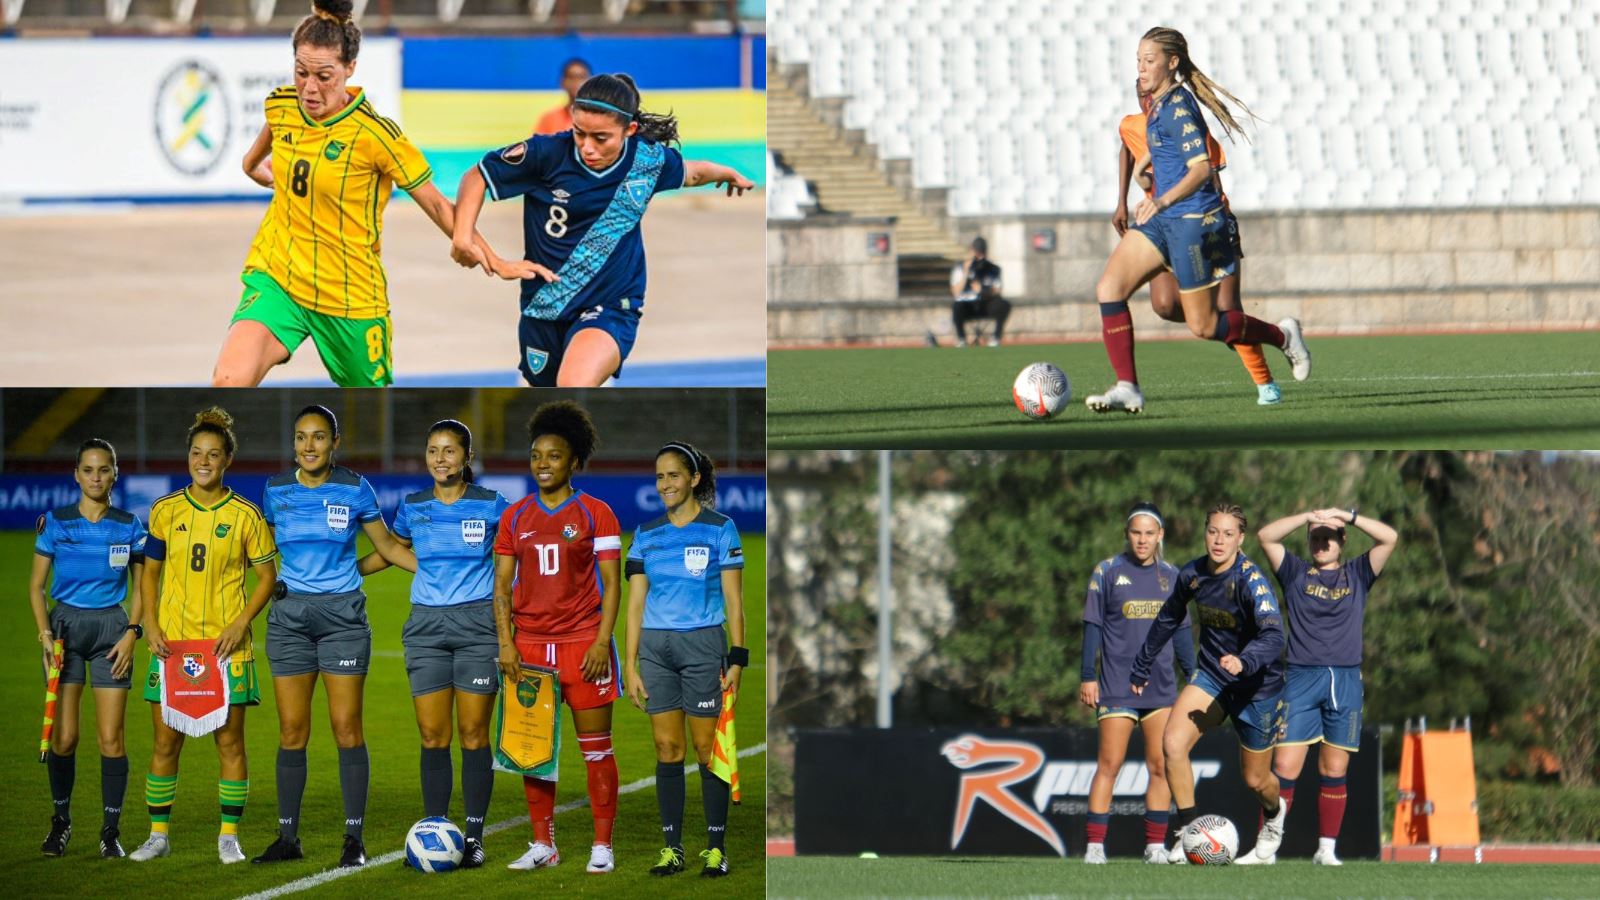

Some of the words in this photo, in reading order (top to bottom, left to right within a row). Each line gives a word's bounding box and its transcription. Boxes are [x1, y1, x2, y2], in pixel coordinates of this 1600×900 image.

[292, 160, 310, 198] 8
[545, 205, 568, 238] 8
[365, 326, 383, 362] 8
[330, 506, 347, 515] FIFA
[463, 521, 483, 529] FIFA
[111, 546, 129, 555] FIFA
[191, 543, 206, 572] 8
[534, 544, 560, 576] 10
[686, 548, 707, 557] FIFA
